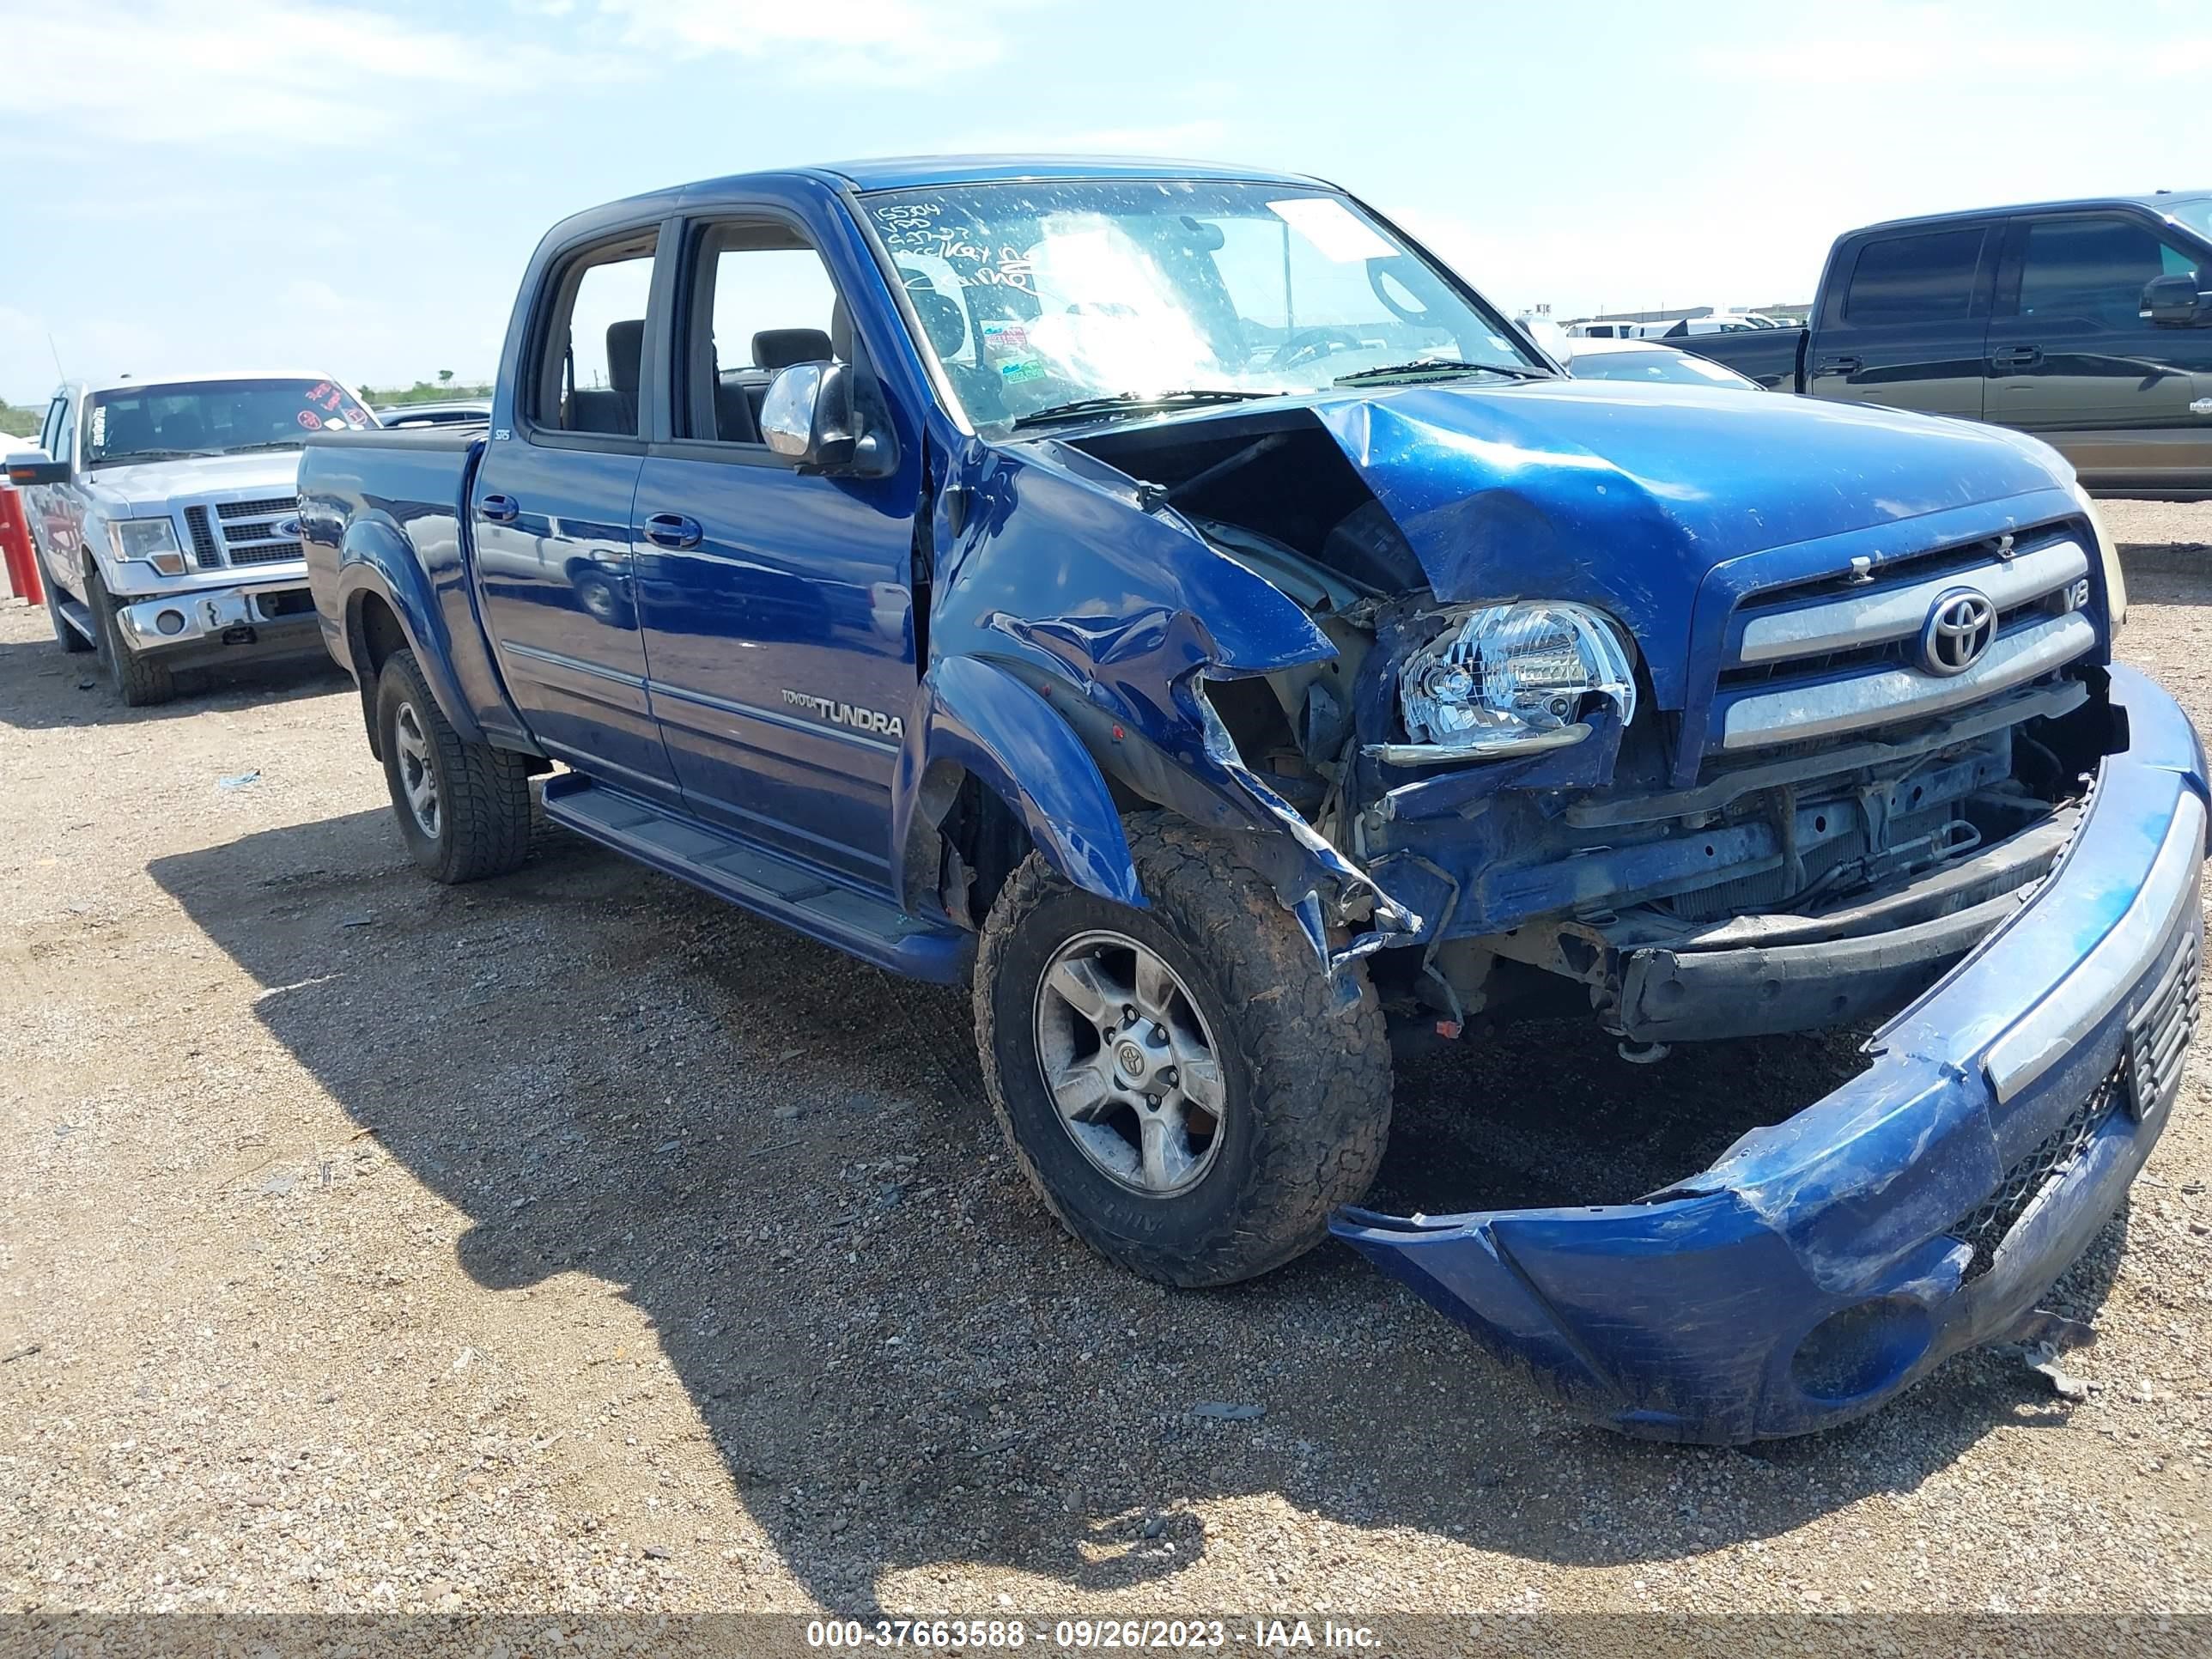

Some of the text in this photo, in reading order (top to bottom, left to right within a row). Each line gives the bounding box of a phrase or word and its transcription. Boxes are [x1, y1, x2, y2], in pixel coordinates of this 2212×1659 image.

[2063, 579, 2088, 611] V8
[781, 689, 903, 738] TOYOTA TUNDRA
